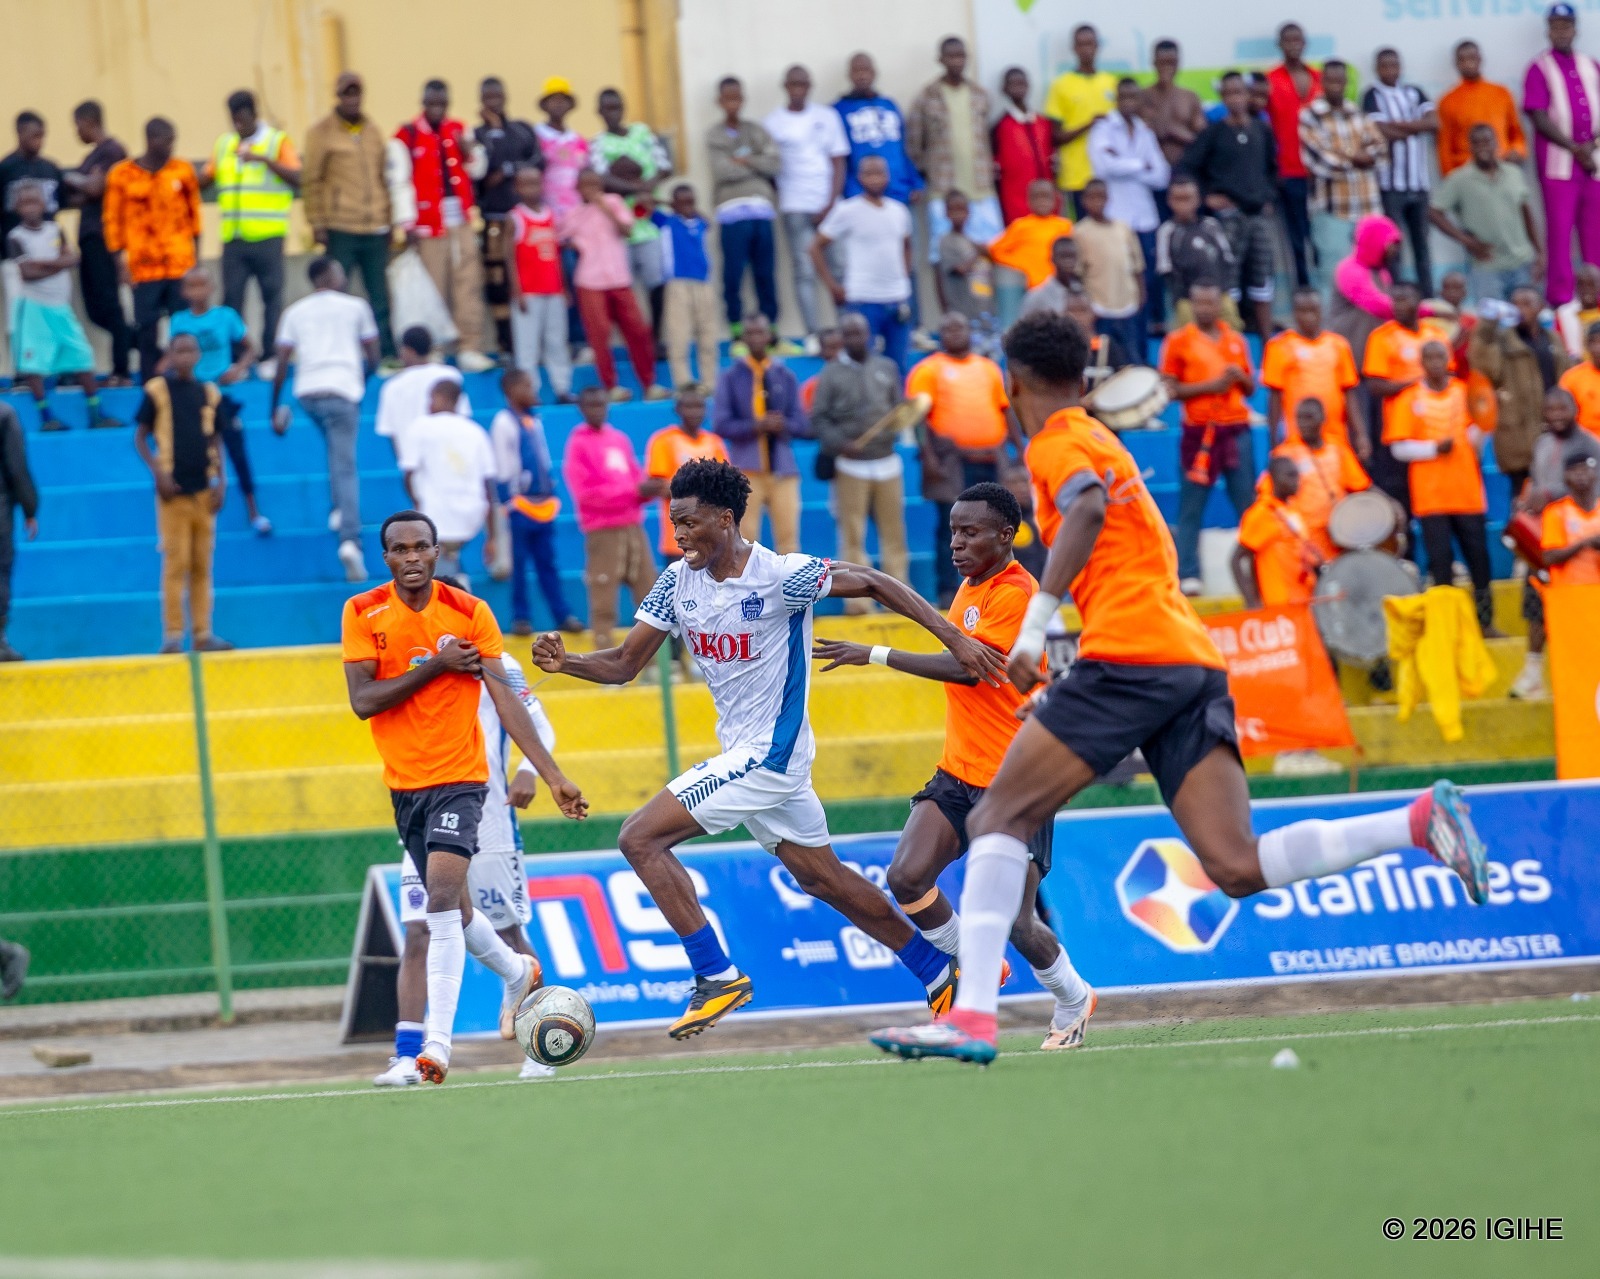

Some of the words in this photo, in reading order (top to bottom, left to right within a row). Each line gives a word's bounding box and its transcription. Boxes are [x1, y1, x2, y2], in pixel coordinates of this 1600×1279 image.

[372, 632, 387, 650] 13
[440, 811, 460, 829] 13
[478, 888, 506, 909] 24
[1269, 944, 1395, 974] EXCLUSIVE
[1395, 933, 1563, 966] BROADCASTER
